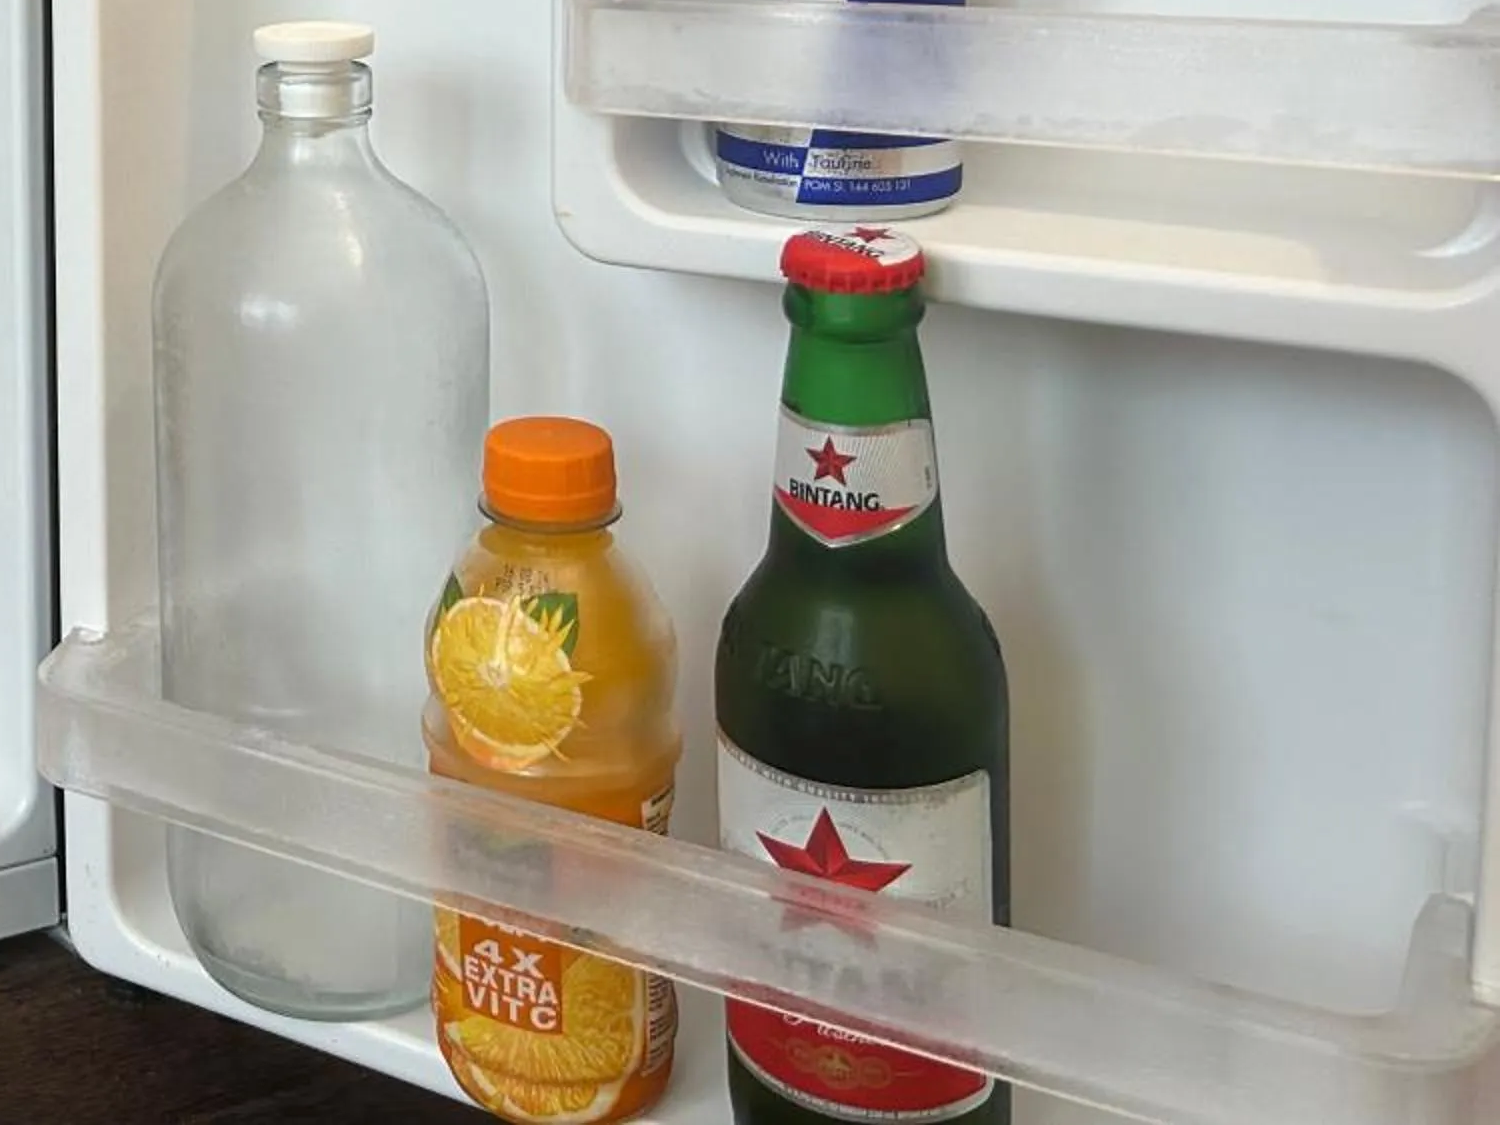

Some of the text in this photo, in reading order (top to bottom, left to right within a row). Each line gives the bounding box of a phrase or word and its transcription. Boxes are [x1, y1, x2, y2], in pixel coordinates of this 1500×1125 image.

[763, 150, 800, 169] With
[789, 477, 883, 513] BINTANG
[464, 954, 559, 1006] EXTRA
[466, 979, 558, 1031] VIT C
